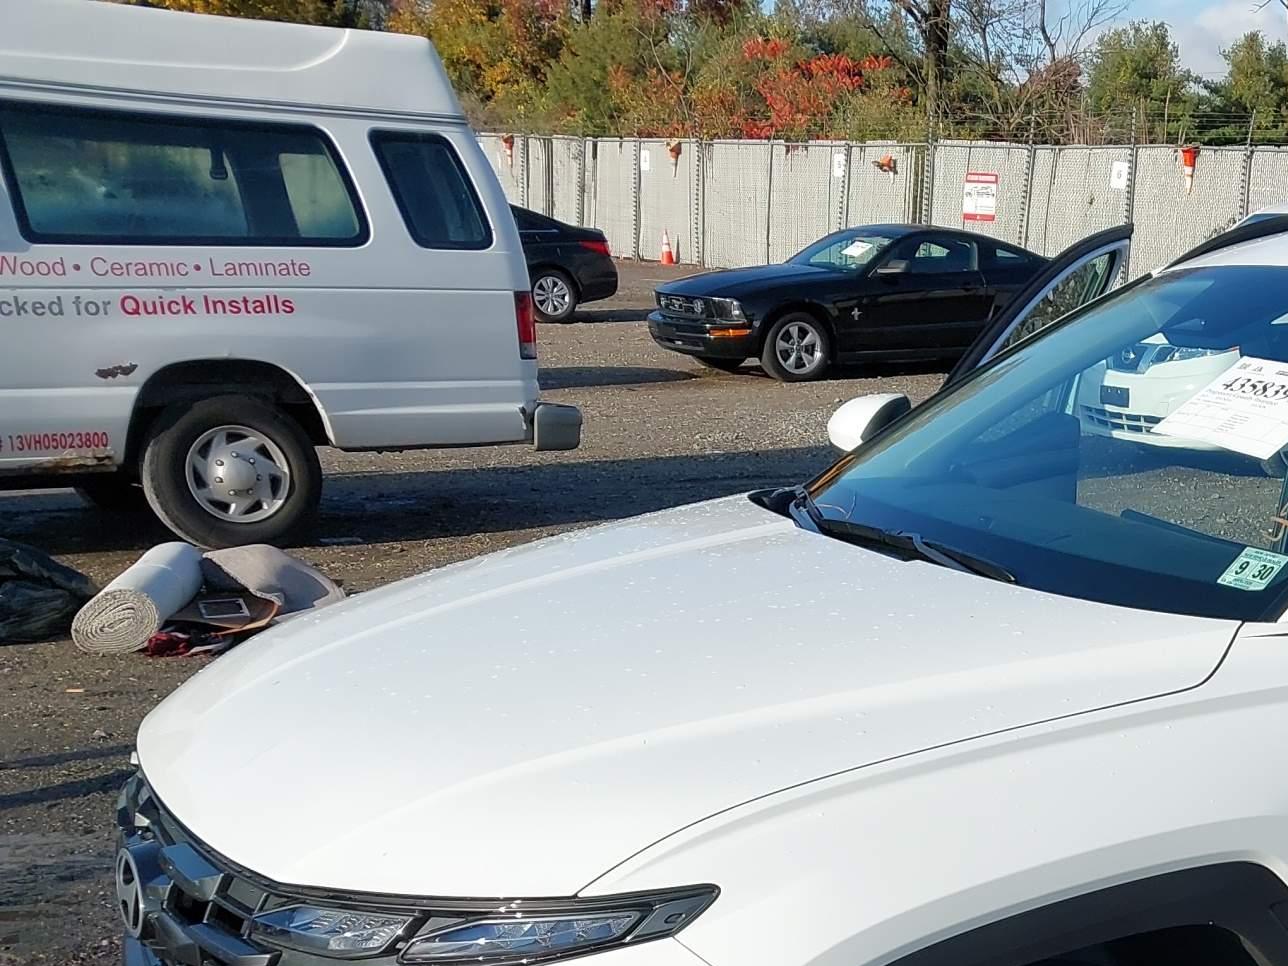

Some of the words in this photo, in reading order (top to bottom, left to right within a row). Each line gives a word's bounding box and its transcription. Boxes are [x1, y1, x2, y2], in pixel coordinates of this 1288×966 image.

[90, 256, 189, 277] Ceramic
[209, 256, 311, 277] Laminate
[72, 295, 111, 316] for
[120, 294, 197, 316] Quick
[203, 294, 295, 314] Installs
[8, 431, 109, 451] 13VH05023800
[1234, 560, 1250, 576] 9
[1252, 563, 1275, 581] 30
